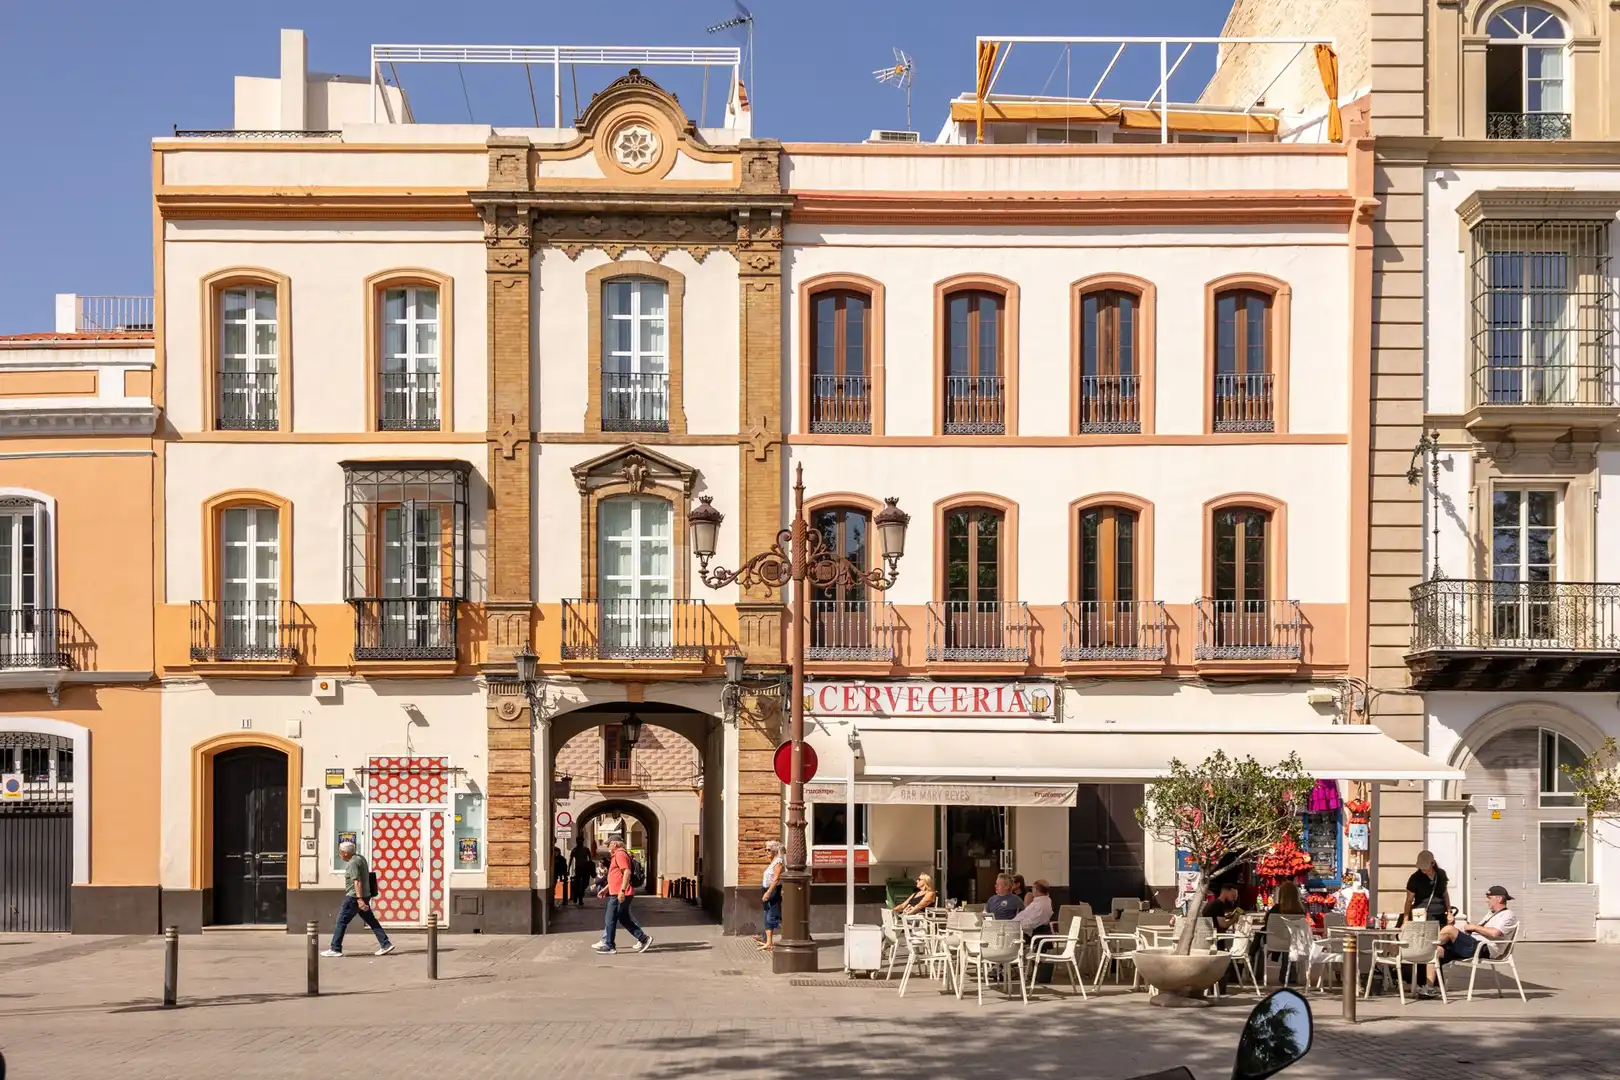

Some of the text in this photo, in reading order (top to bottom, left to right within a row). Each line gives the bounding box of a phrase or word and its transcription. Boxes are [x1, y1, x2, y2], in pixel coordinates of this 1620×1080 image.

[819, 684, 1028, 713] CERVECERIA
[901, 789, 970, 801] BAR MARY REYES
